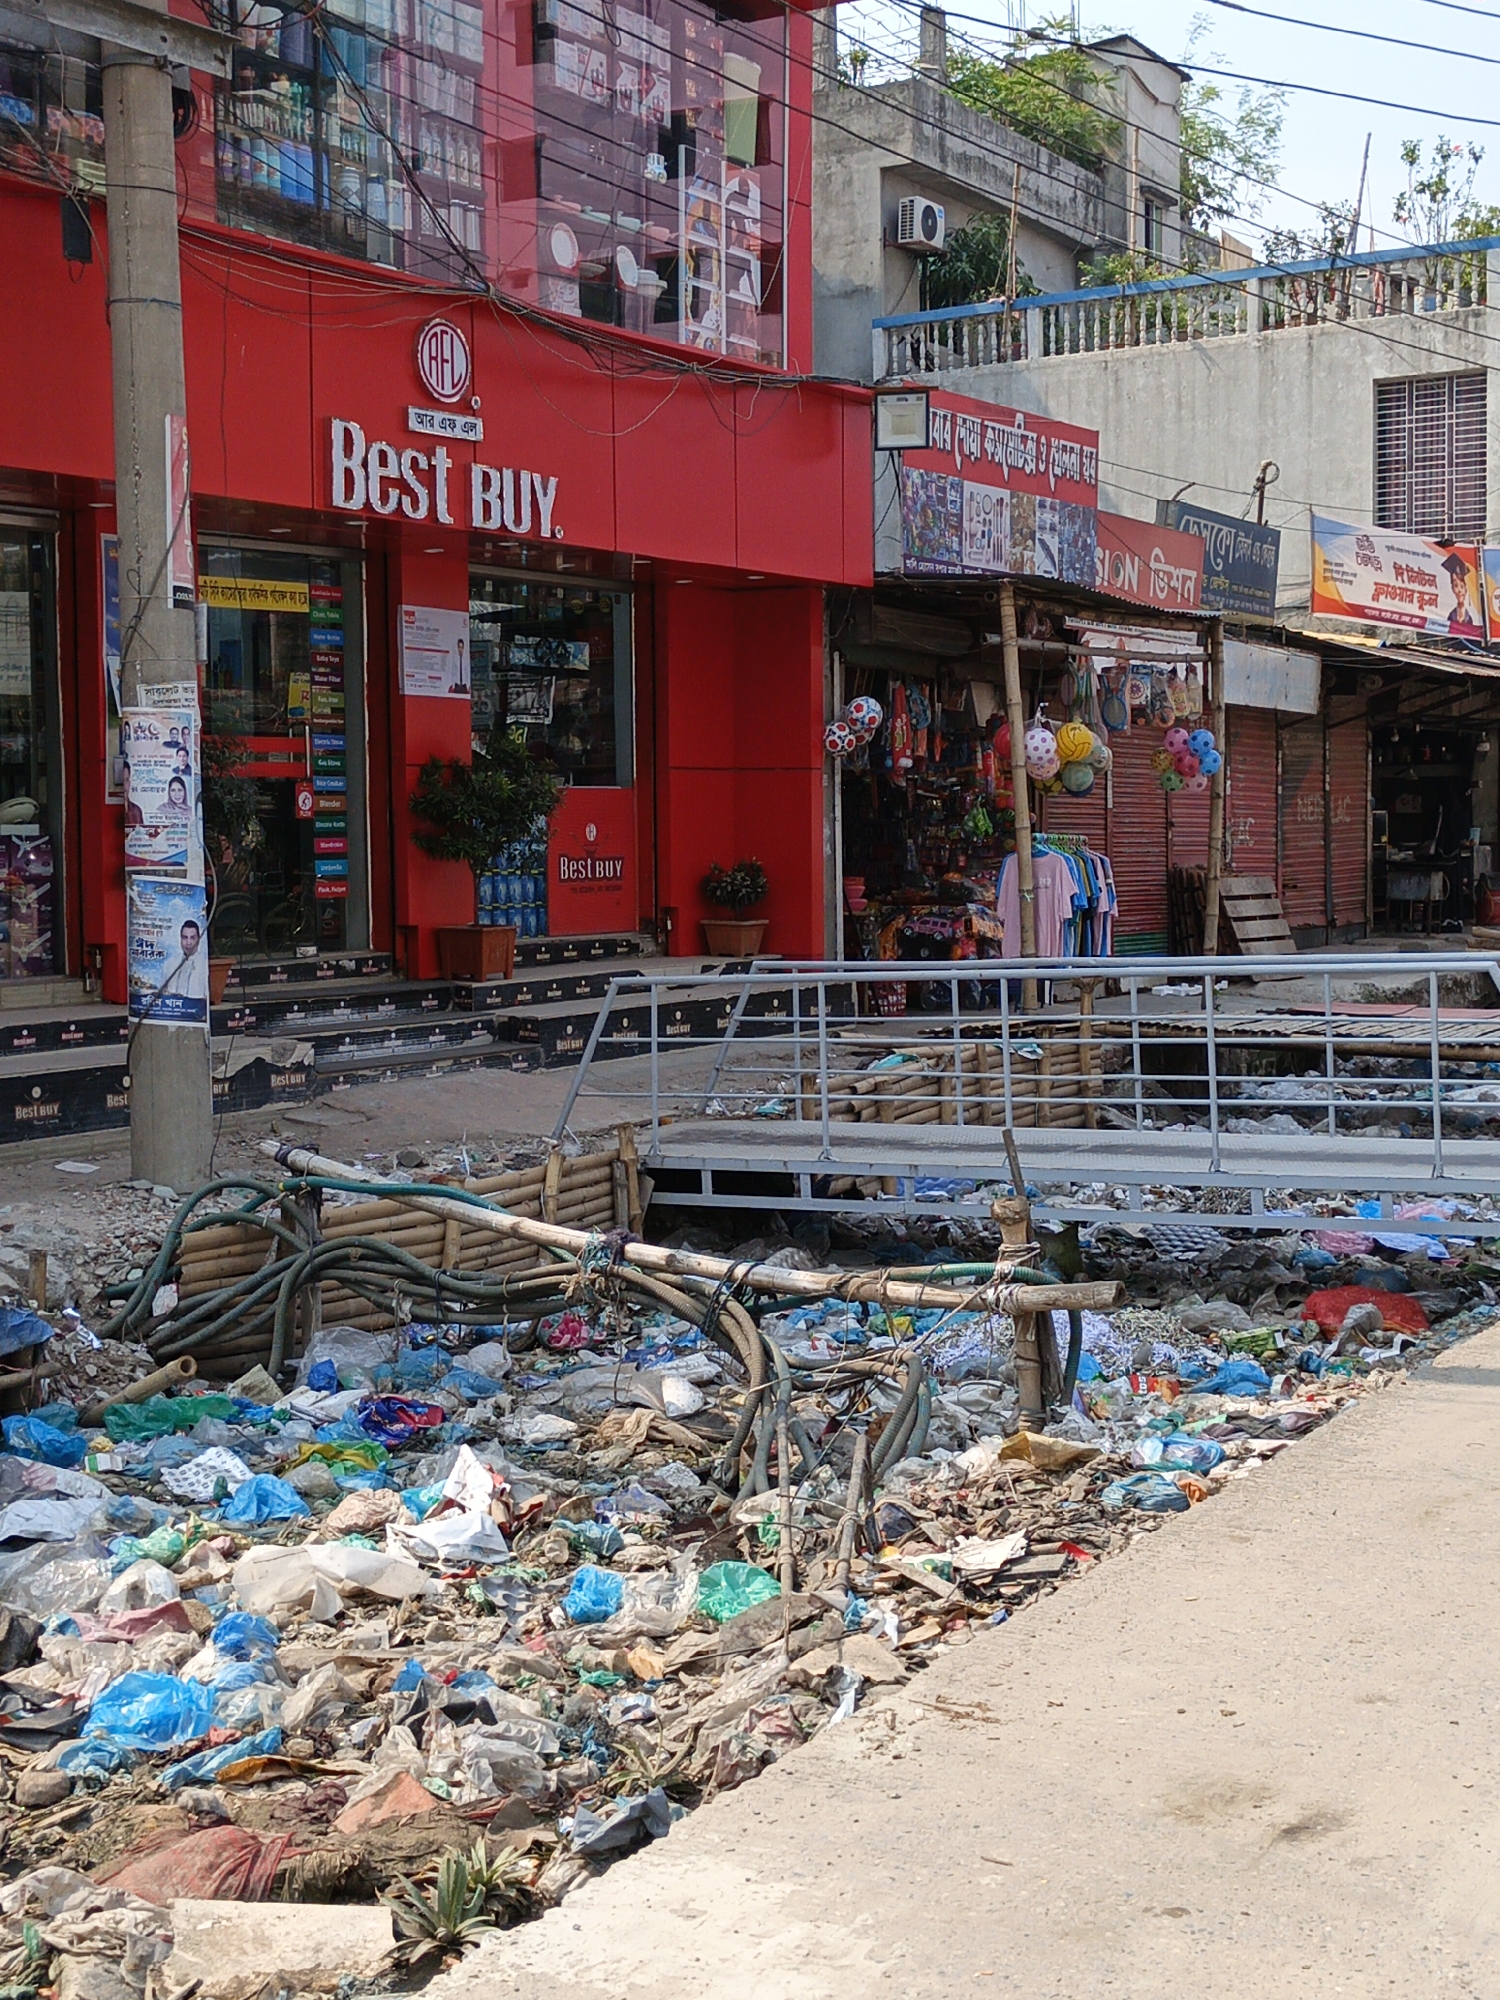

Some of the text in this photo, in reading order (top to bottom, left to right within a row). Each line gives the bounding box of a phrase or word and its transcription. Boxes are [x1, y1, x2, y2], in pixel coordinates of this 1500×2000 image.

[428, 328, 463, 392] RFL
[414, 411, 478, 436] আর এফ এল
[1038, 435, 1047, 473] ও
[330, 416, 559, 538] Best BUY
[1149, 546, 1198, 606] ভিশন
[1416, 592, 1439, 612] স্কুল
[560, 856, 622, 879] Best BUY
[271, 1073, 306, 1087] Best BUY
[15, 1103, 60, 1120] Best BUY
[107, 1094, 128, 1108] Best
